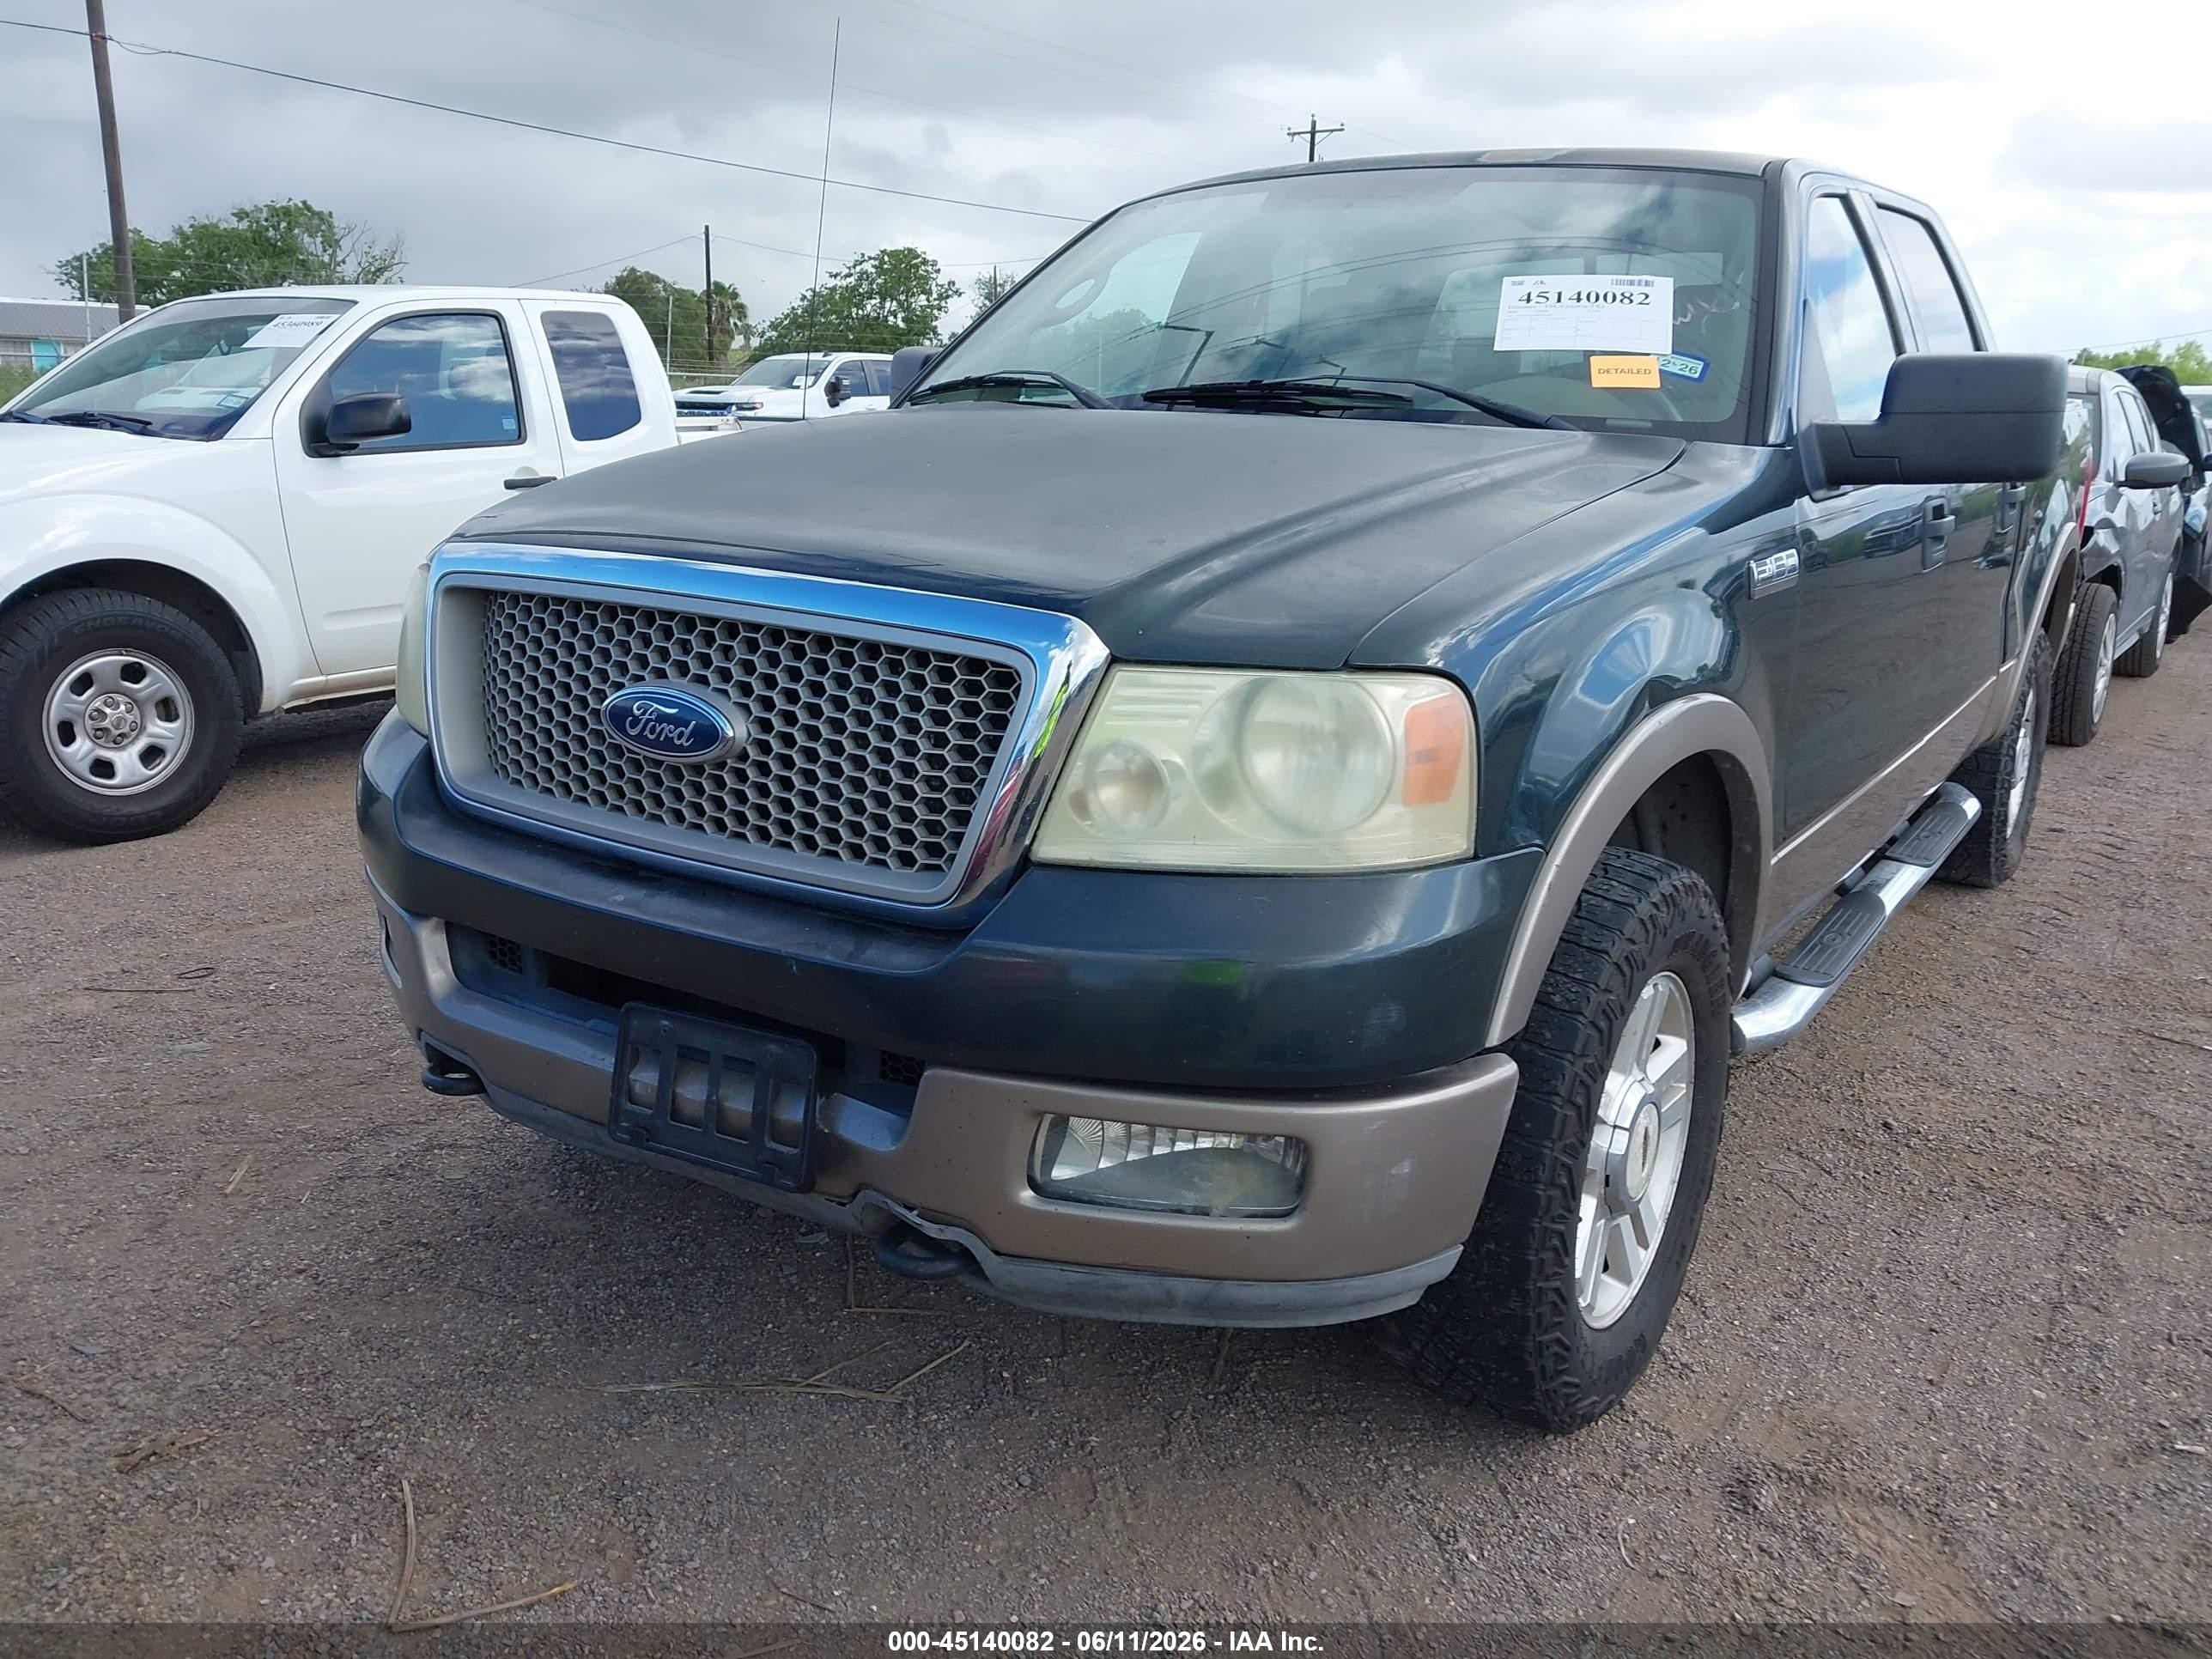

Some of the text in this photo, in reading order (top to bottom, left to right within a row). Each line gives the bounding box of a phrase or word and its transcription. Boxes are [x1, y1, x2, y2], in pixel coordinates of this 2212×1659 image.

[1518, 289, 1651, 306] 45140082
[1597, 367, 1652, 375] DETAILED
[1677, 362, 1699, 375] 26
[625, 700, 697, 747] Ford
